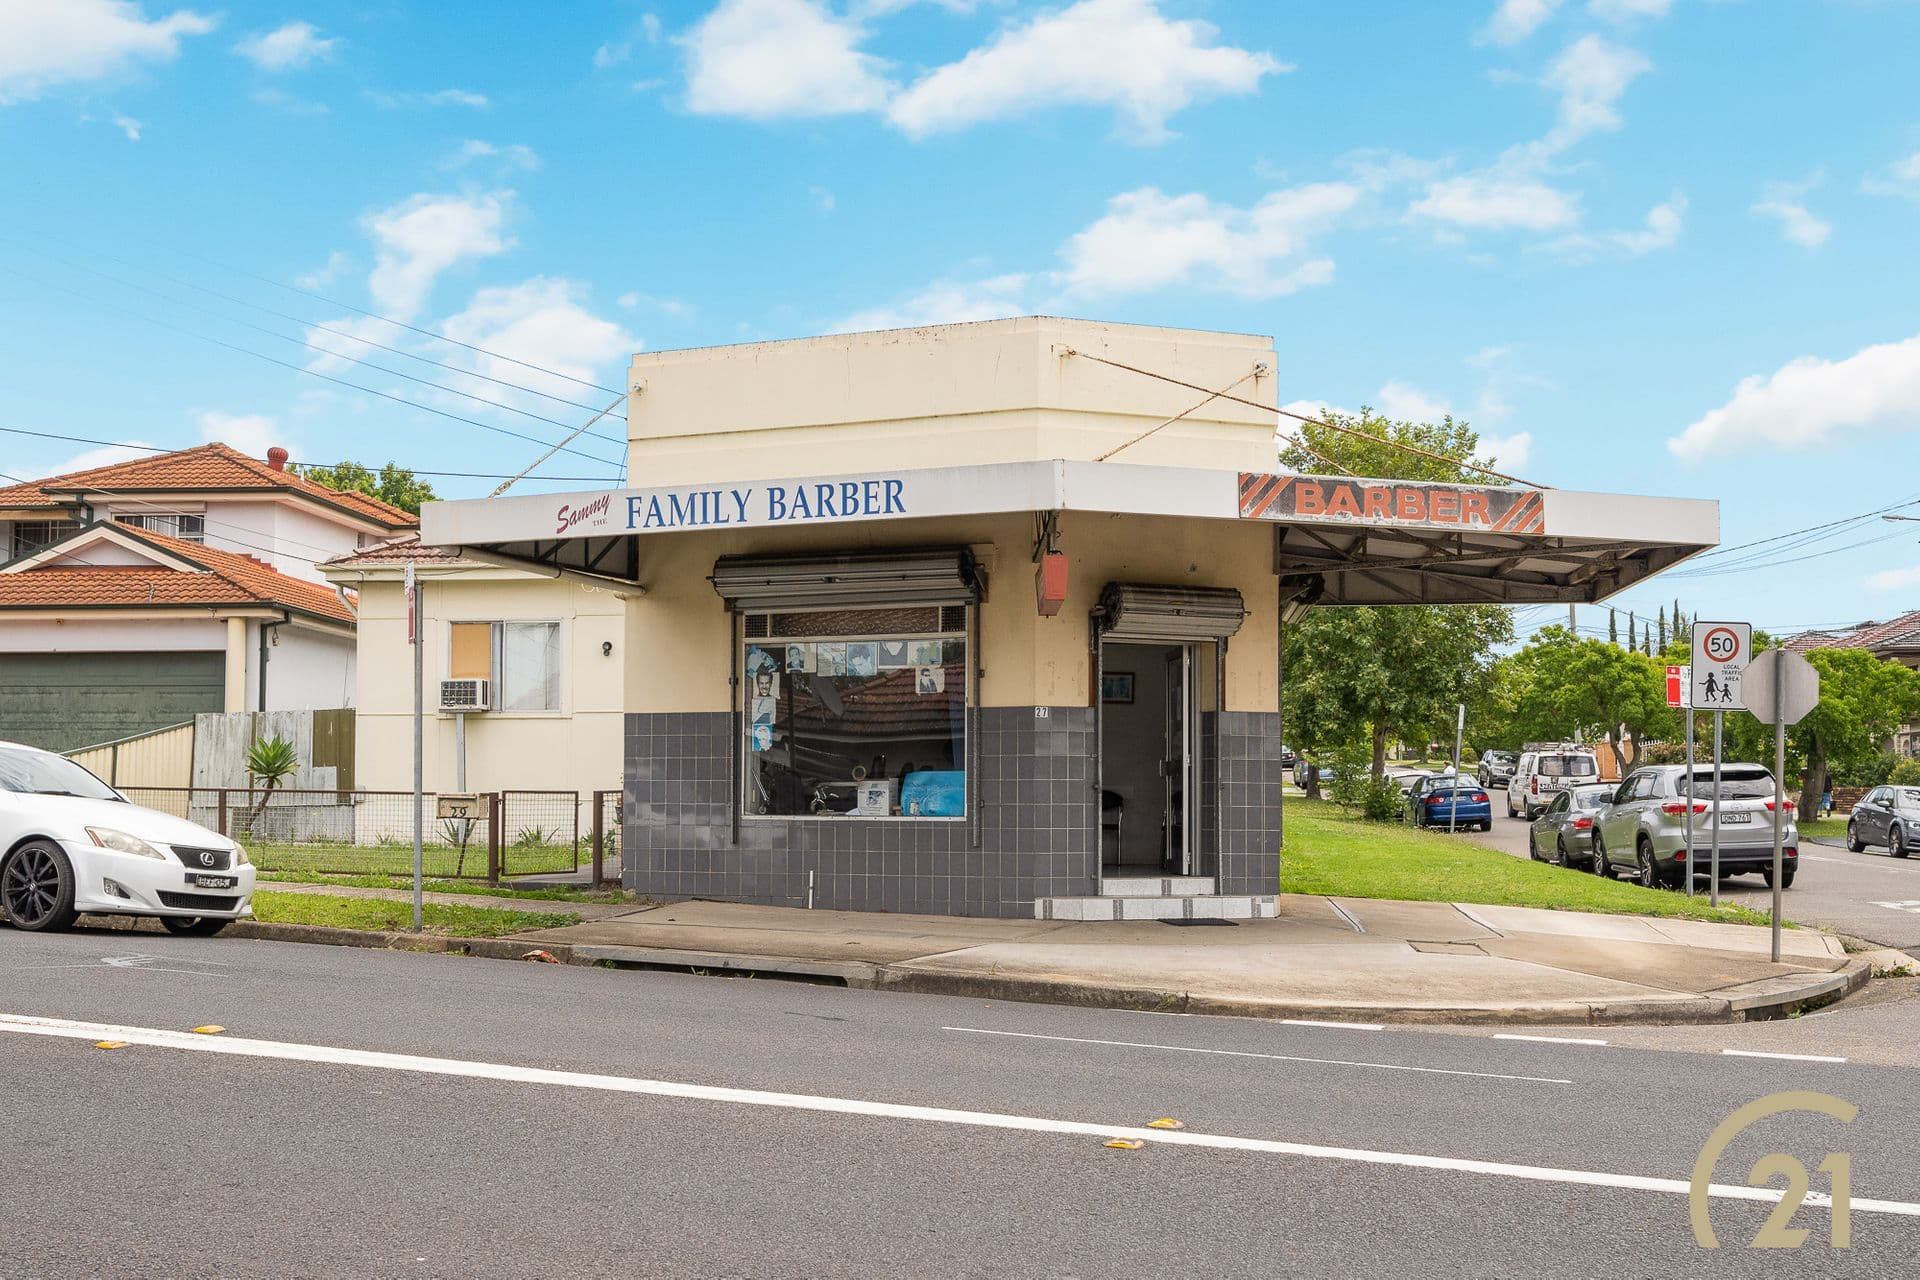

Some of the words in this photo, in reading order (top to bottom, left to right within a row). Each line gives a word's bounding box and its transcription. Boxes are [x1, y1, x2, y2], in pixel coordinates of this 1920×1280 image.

[556, 493, 610, 534] Sammy
[625, 488, 753, 529] FAMILY
[766, 478, 906, 522] BARBER
[1294, 482, 1492, 524] BARBER
[1710, 637, 1733, 653] 50
[1036, 708, 1047, 716] 27
